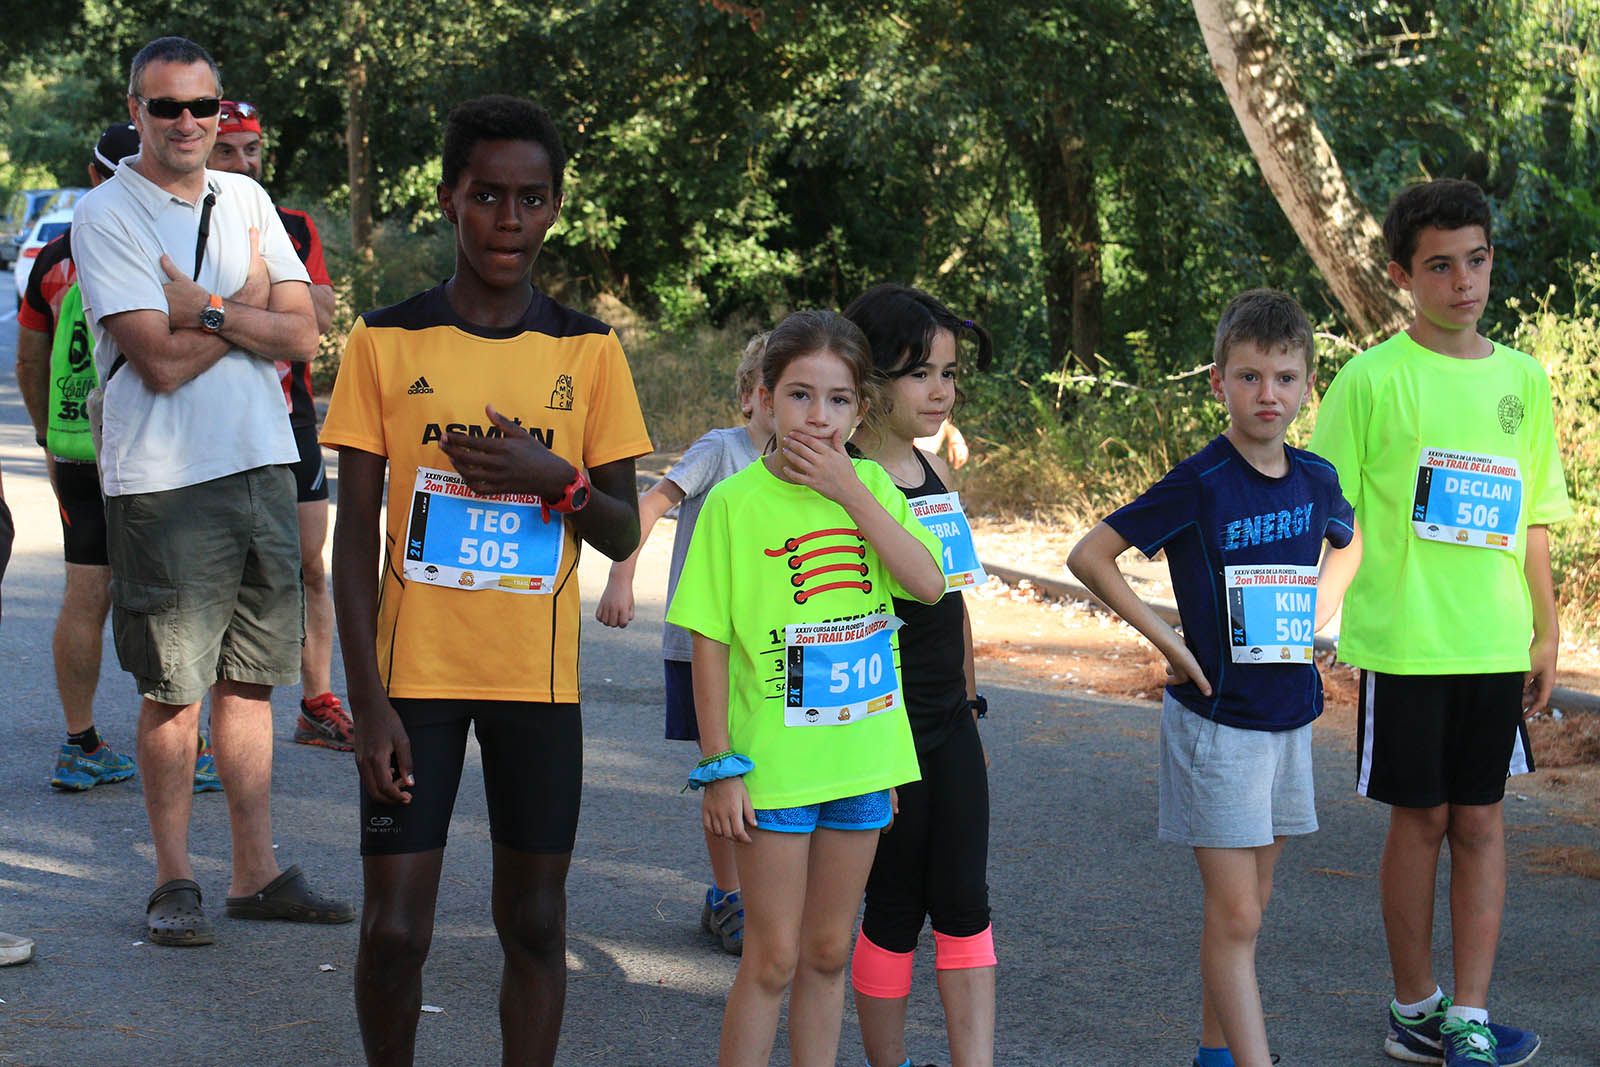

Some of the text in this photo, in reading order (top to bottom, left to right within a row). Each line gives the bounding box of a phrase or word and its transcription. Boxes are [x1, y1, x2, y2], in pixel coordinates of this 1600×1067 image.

[407, 386, 434, 395] adidas
[1427, 456, 1516, 477] 2on TRAIL DE LA FLORESTA
[424, 480, 443, 493] 2on
[425, 472, 442, 481] XXXIV
[442, 474, 460, 484] CURSA
[1444, 476, 1512, 502] DECLAN
[466, 507, 521, 535] TEO
[1414, 504, 1425, 520] 2K
[1456, 502, 1500, 529] 506
[926, 521, 960, 539] EBRA
[1223, 502, 1314, 550] ENERGY
[410, 540, 422, 558] 2K
[458, 537, 519, 569] 505
[1235, 575, 1252, 586] 2on
[1254, 575, 1277, 585] TRAIL
[1278, 575, 1288, 585] DE
[1288, 575, 1297, 585] LA
[1275, 592, 1311, 613] KIM
[795, 626, 812, 634] XXXIV
[813, 625, 830, 633] CURSA
[838, 624, 845, 632] LA
[795, 633, 815, 644] 2on
[817, 632, 843, 643] TRAIL
[844, 630, 855, 641] DE
[856, 629, 865, 639] LA
[1233, 628, 1244, 644] 2K
[1275, 618, 1312, 642] 502
[829, 653, 882, 693] 510
[789, 688, 801, 705] 2K
